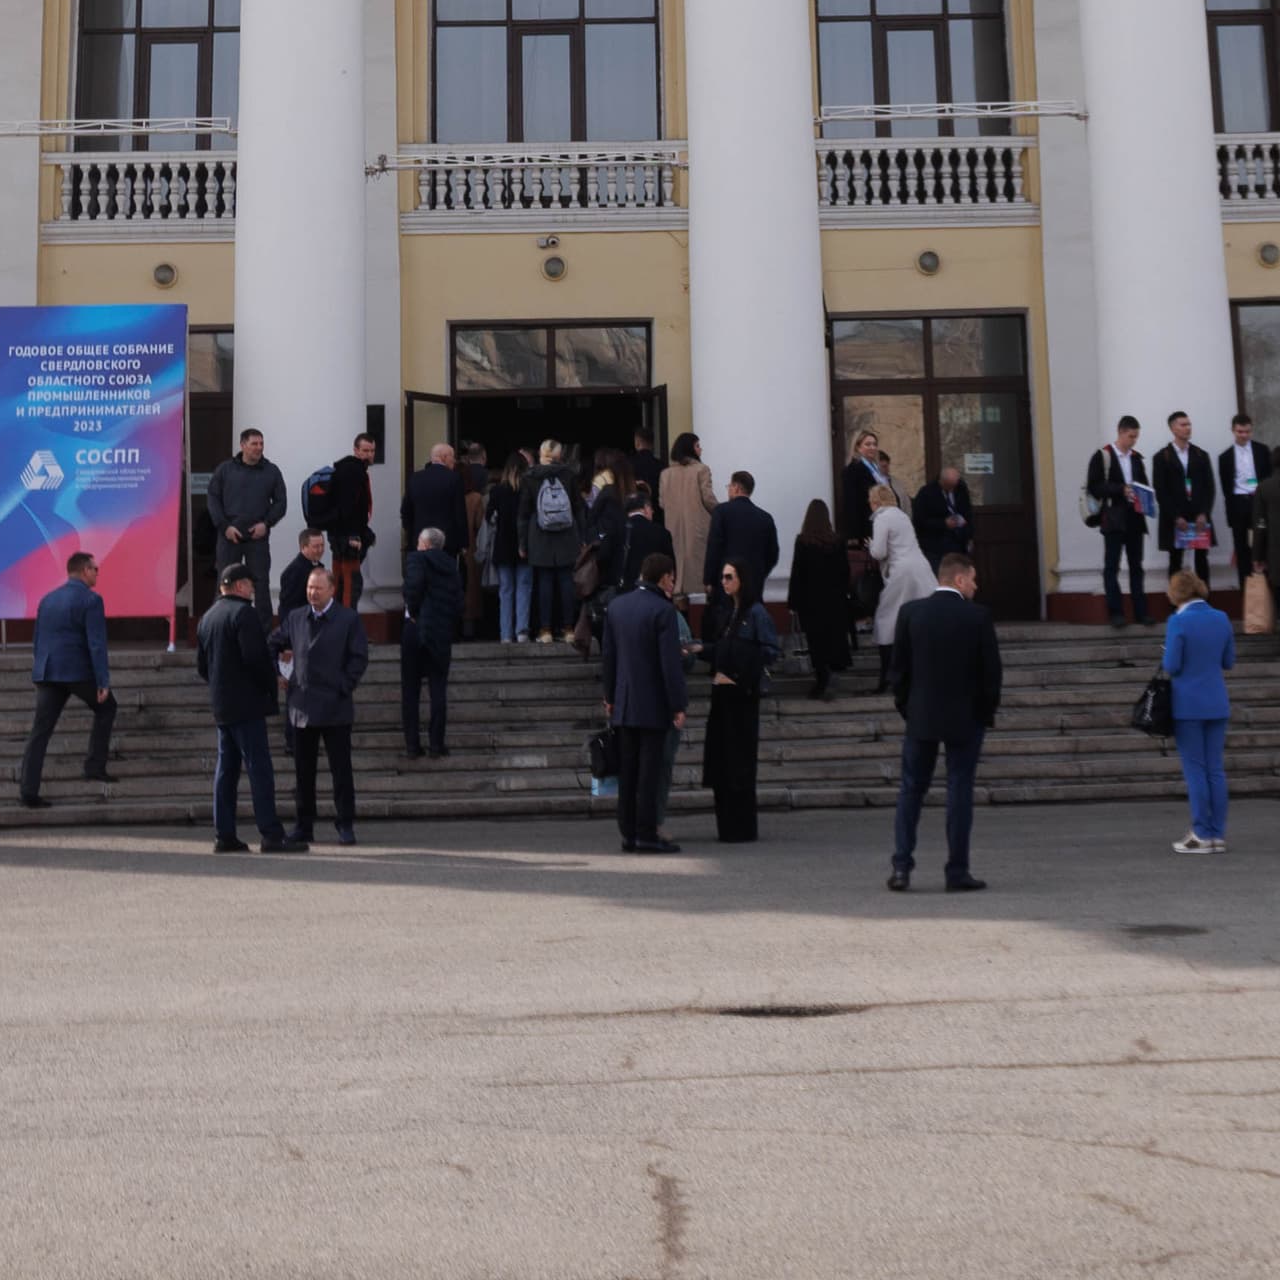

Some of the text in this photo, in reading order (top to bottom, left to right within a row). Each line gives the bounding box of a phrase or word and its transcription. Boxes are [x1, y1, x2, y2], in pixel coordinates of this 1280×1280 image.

[8, 343, 174, 358] ГОДОВОЕ ОБЩЕЕ СОБРАНИЕ
[40, 359, 141, 372] СВЕРДЛОВСКОГО
[27, 373, 152, 387] ОБЛАСТНОГО СОЮЗА
[27, 389, 151, 402] ПРОМЫШЛЕННИКОВ
[16, 402, 161, 418] И ПРЕДПРИНИМАТЕЛЕЙ
[75, 448, 140, 465] СОСПП
